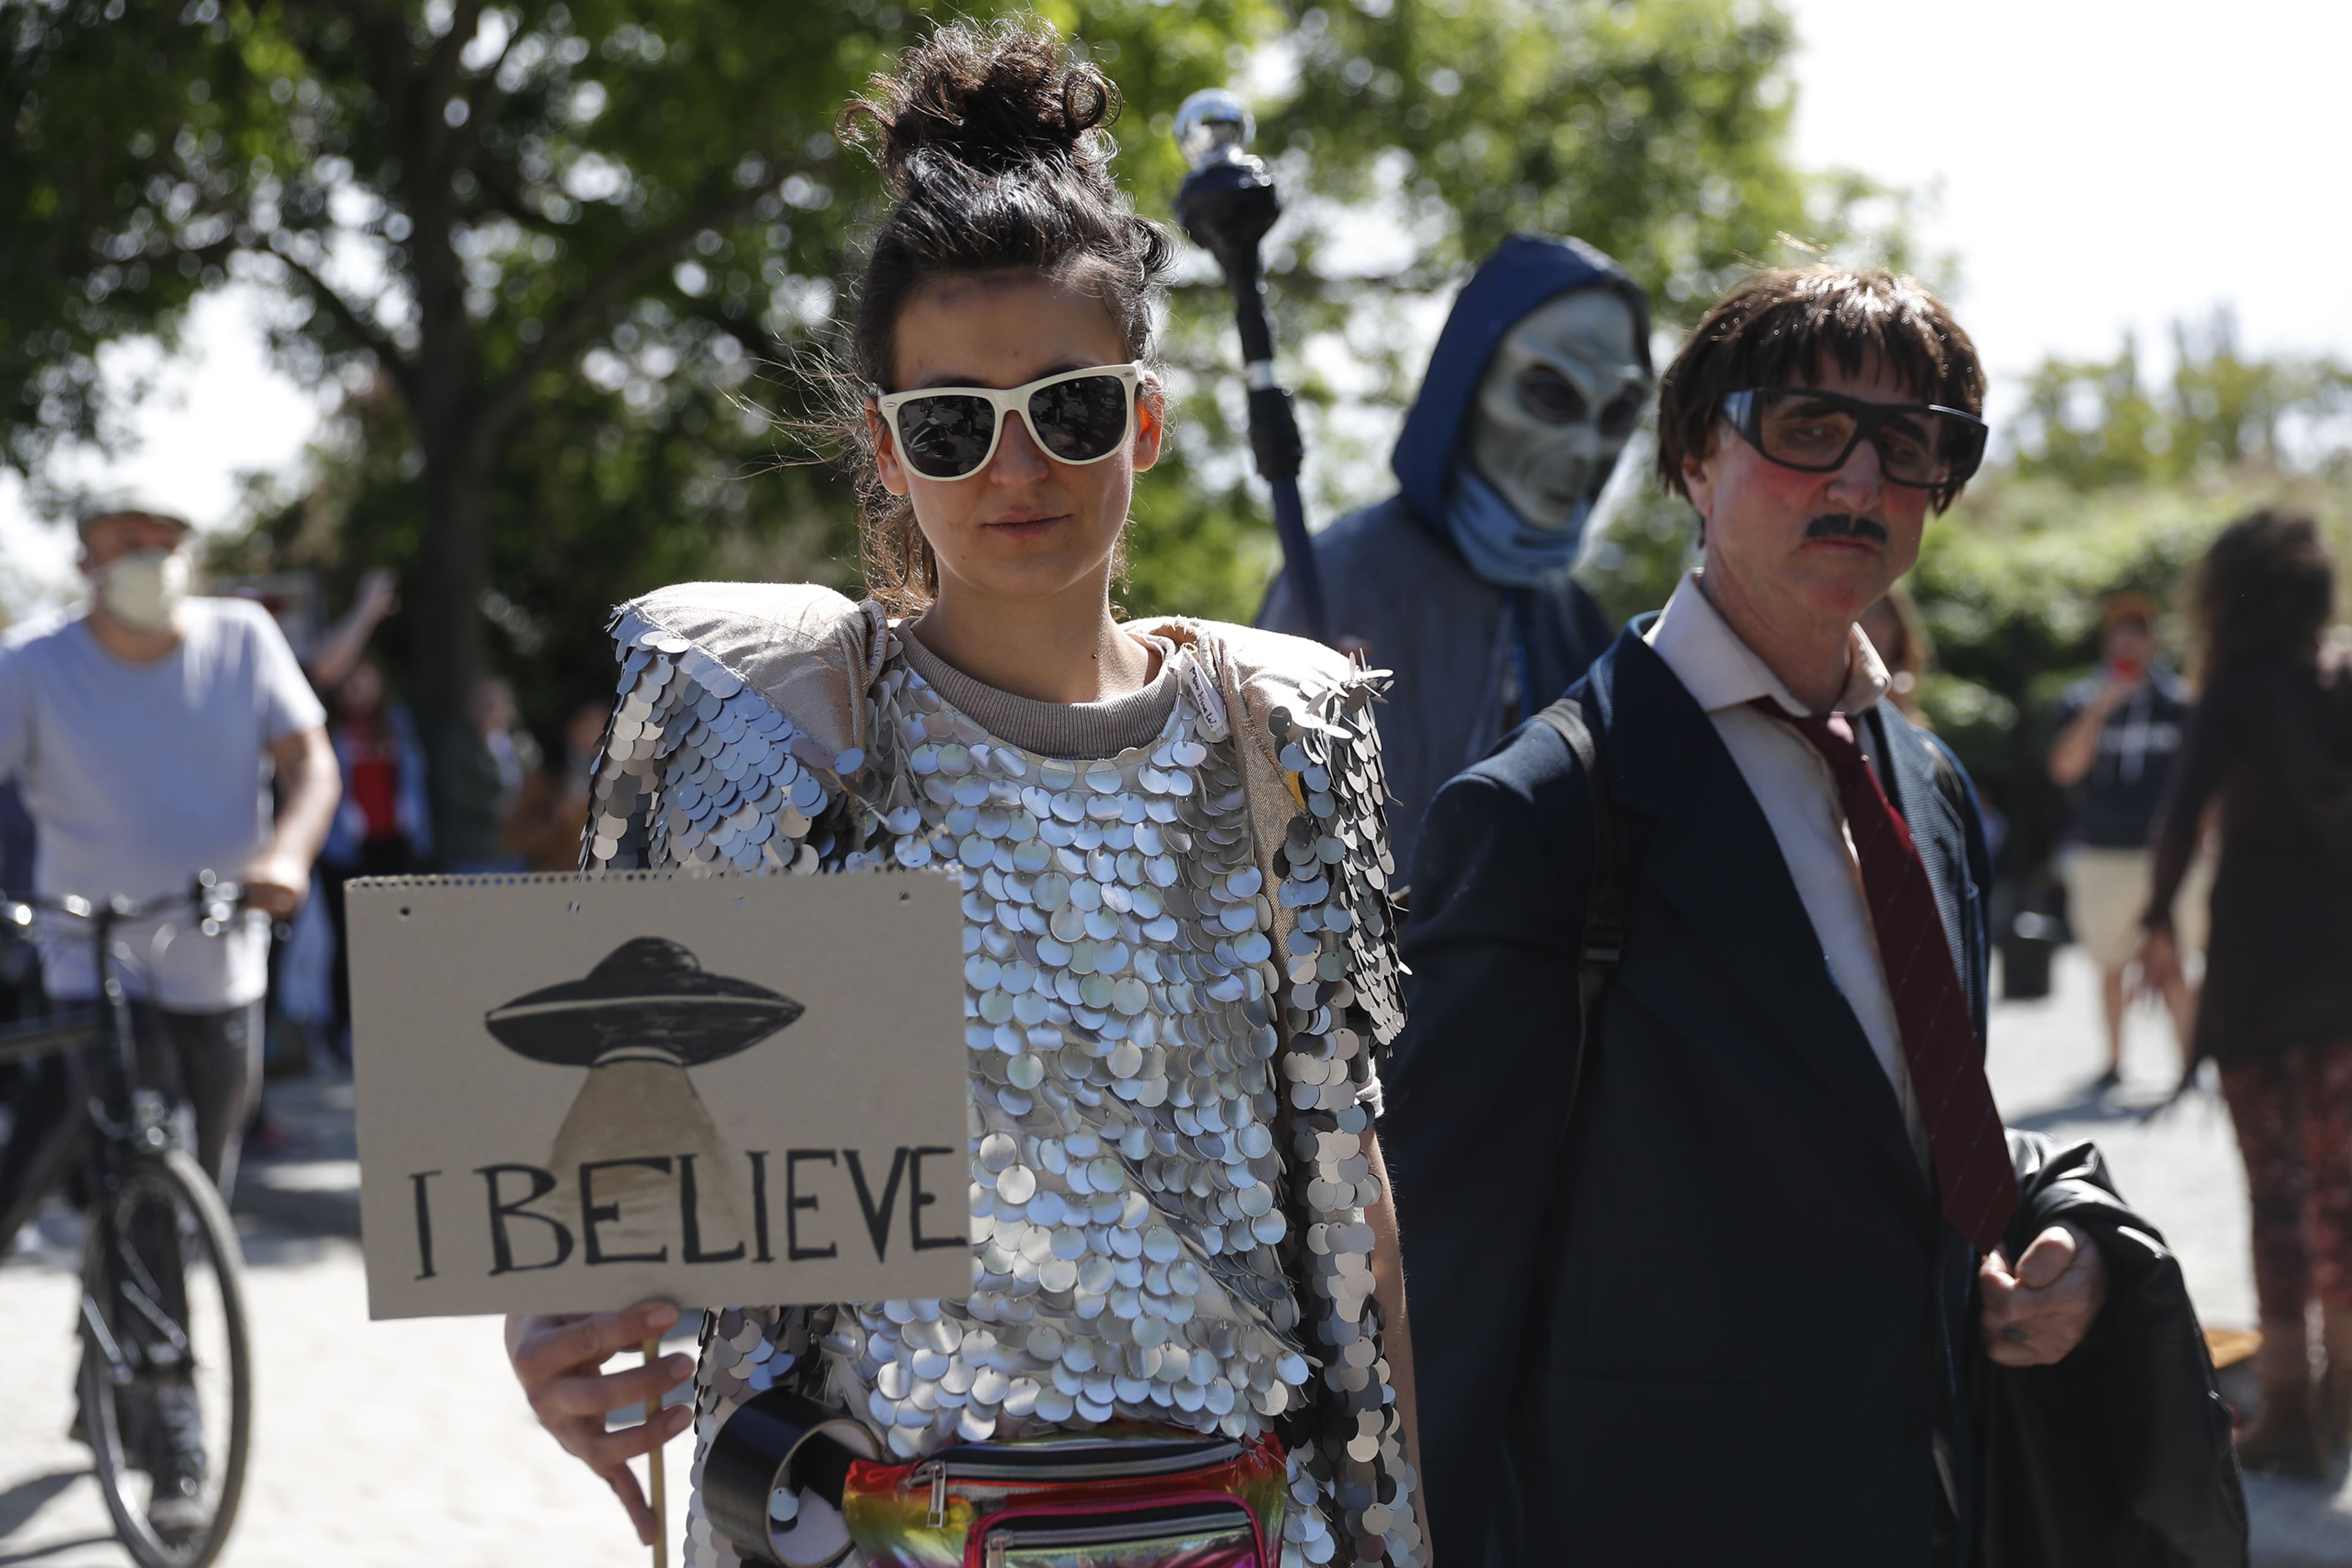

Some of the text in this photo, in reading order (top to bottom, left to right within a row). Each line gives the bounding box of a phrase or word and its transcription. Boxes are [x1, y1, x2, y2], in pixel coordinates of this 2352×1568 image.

[1189, 666, 1208, 714] Martina
[408, 1147, 969, 1281] I BELIEVE
